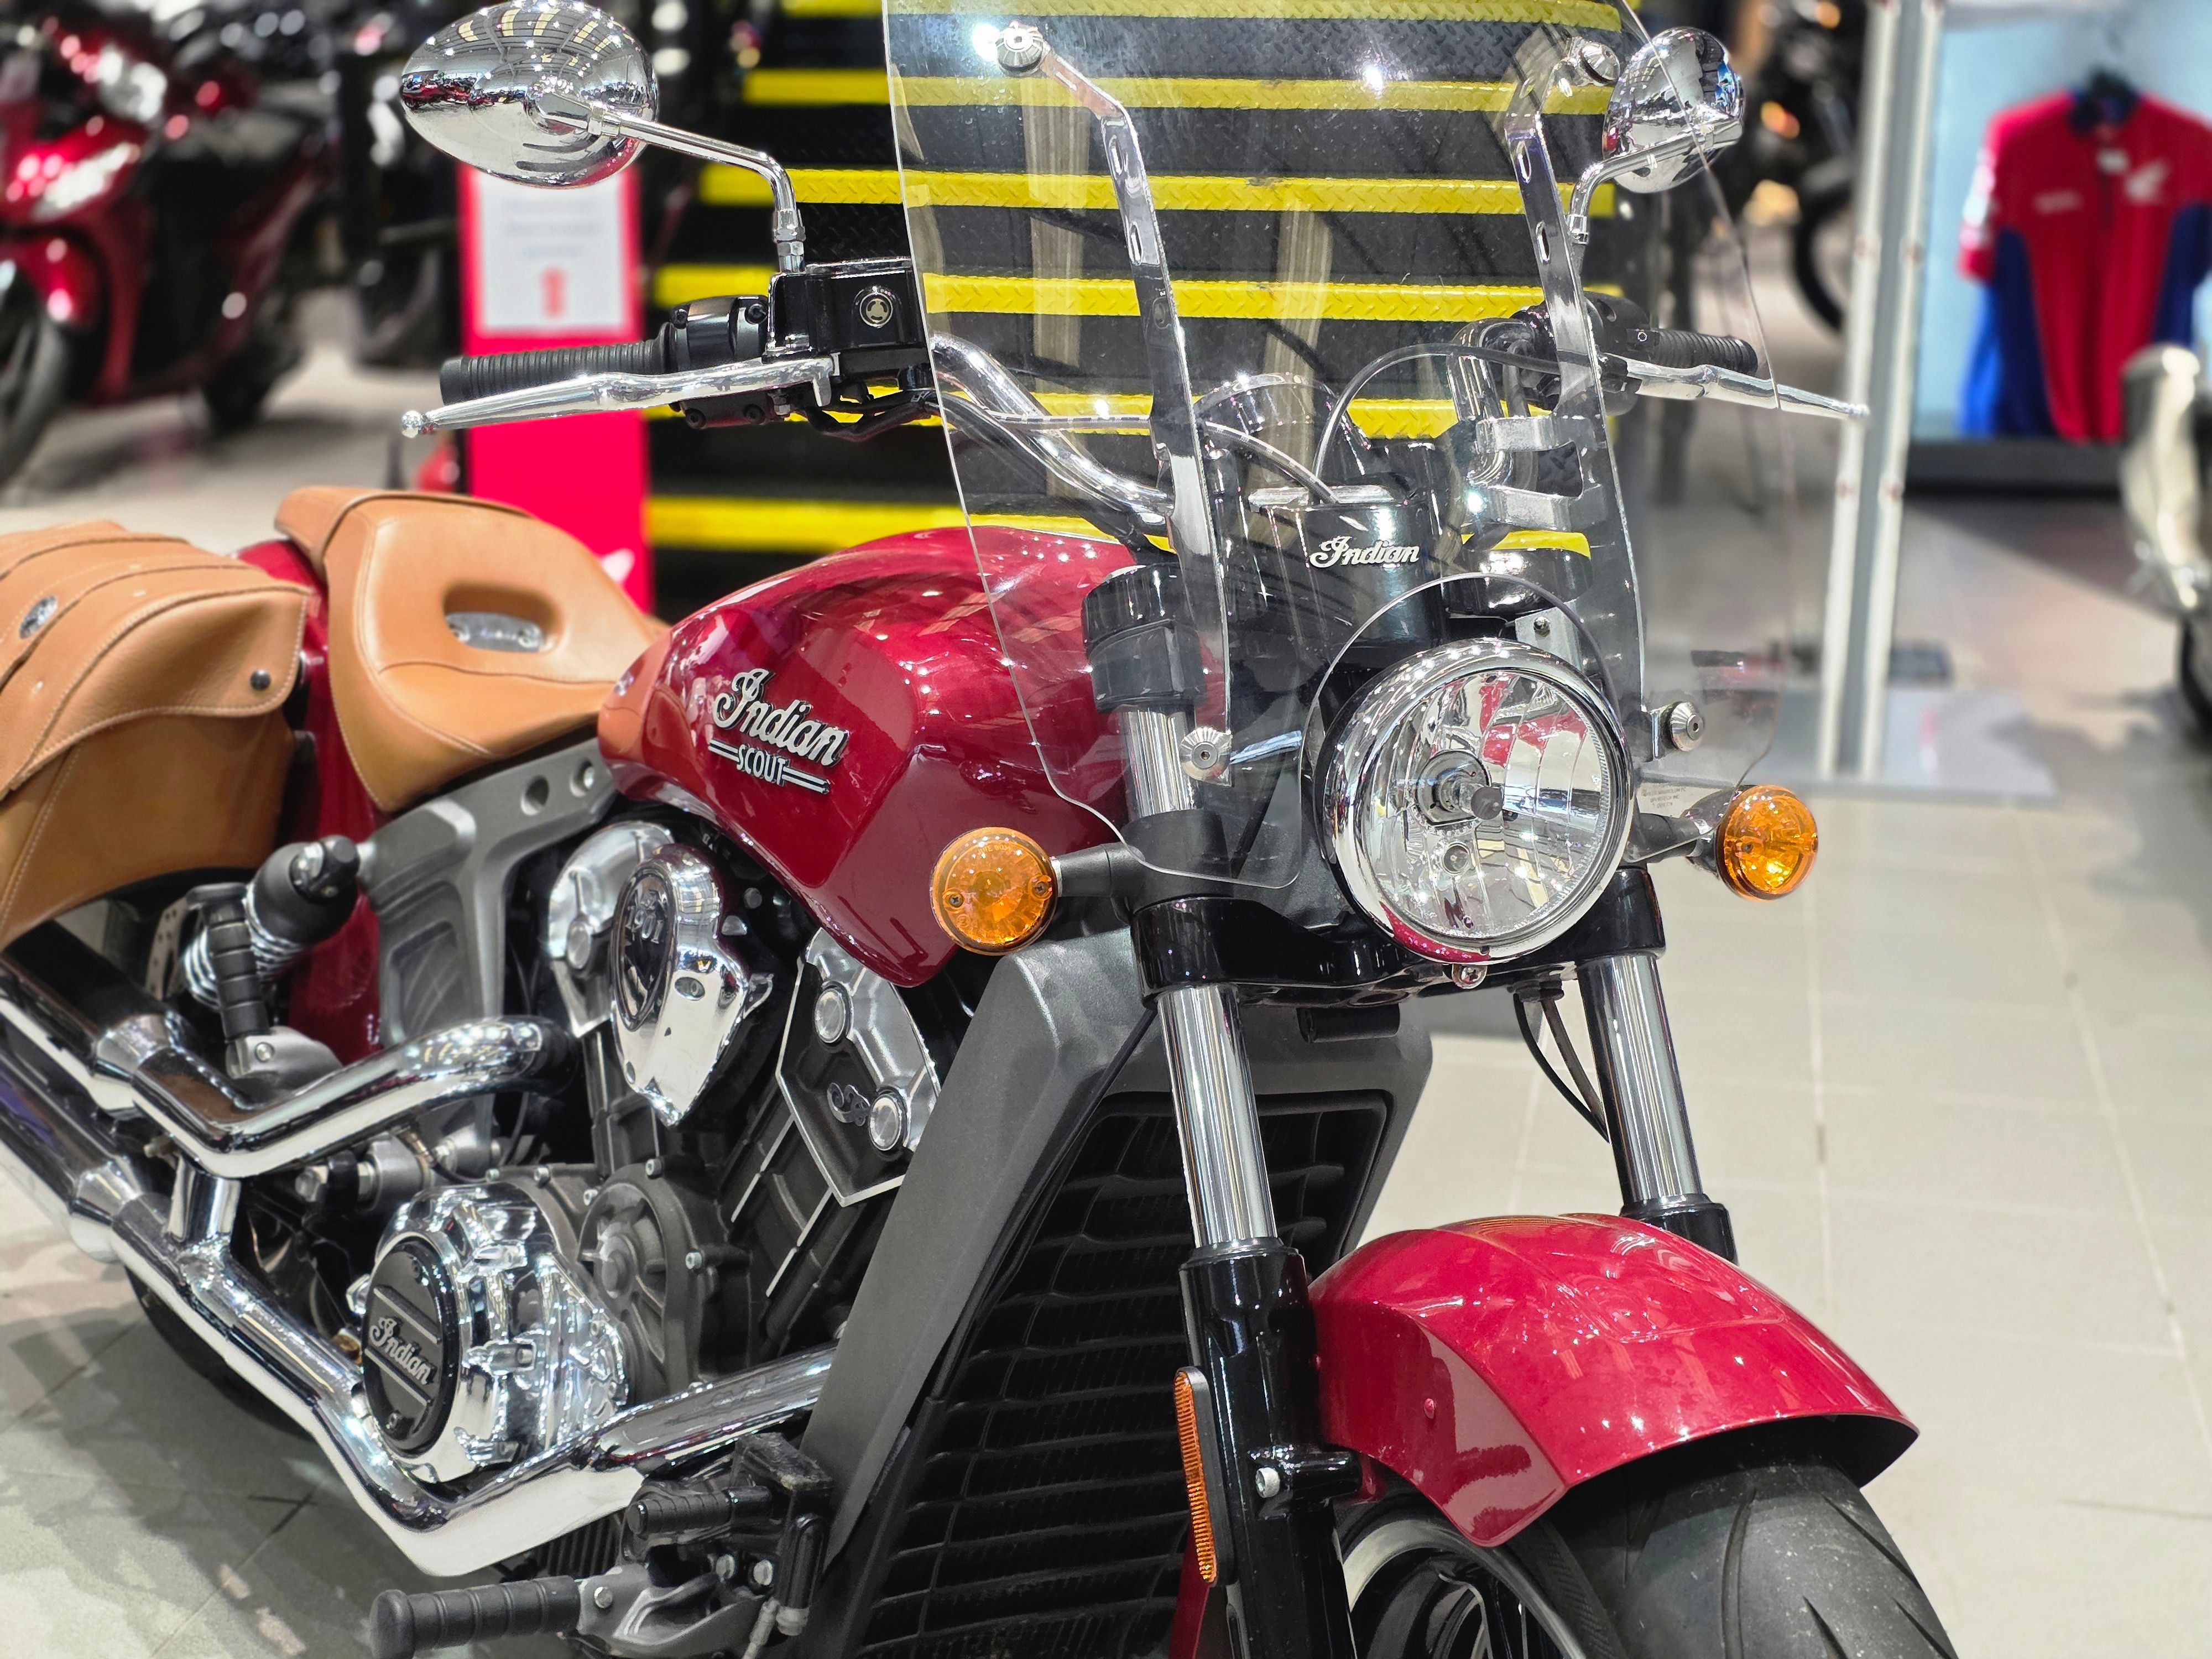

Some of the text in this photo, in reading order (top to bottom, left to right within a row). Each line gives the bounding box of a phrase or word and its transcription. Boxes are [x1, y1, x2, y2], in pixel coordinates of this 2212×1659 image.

[1309, 535, 1420, 568] Indian
[713, 668, 848, 766] Indian
[737, 744, 789, 785] SCOUT
[369, 1317, 432, 1385] Indian
